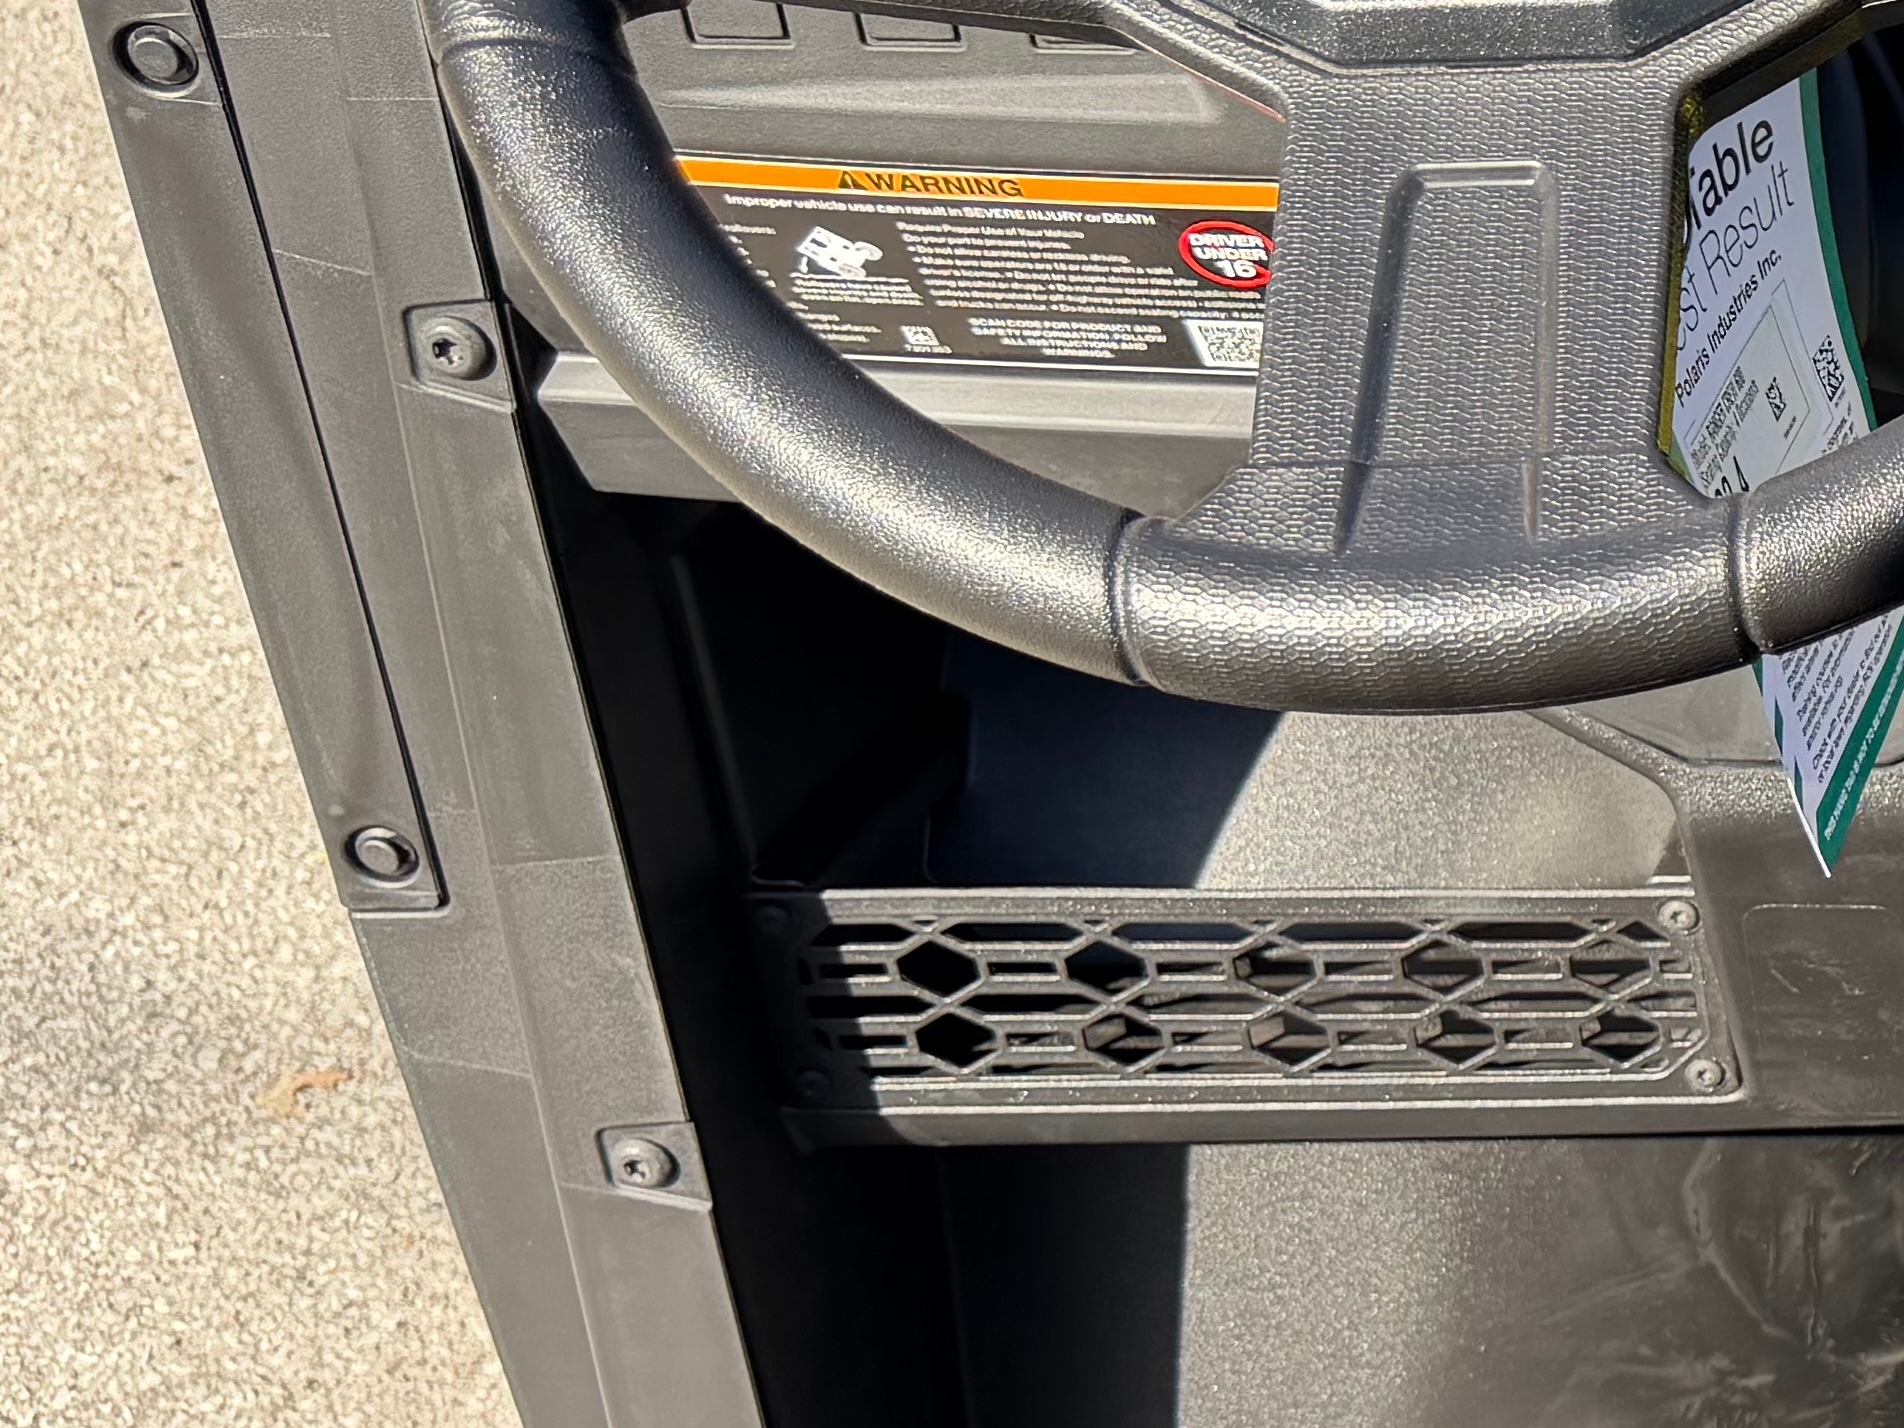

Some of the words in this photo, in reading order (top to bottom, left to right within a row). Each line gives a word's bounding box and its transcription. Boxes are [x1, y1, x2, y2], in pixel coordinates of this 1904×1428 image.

[864, 174, 1023, 196] WARNING
[725, 195, 793, 209] Improper
[794, 198, 846, 211] vehicle
[848, 201, 874, 213] use
[876, 202, 902, 214] can
[905, 204, 945, 216] result
[948, 206, 961, 216] in
[963, 207, 1024, 219] SEVERE
[1027, 210, 1083, 222] INJURY
[1084, 213, 1102, 223] or
[1103, 213, 1155, 225] DEATH
[1699, 161, 1795, 295] Result
[1189, 234, 1264, 247] DRIVER
[1193, 247, 1268, 260] UNDER
[1217, 260, 1256, 277] 16
[969, 318, 1005, 326] SCAN
[1007, 319, 1042, 328] CODE
[1044, 321, 1069, 329] FOR
[1072, 322, 1132, 331] PRODUCT
[1134, 324, 1161, 332] AND
[1676, 347, 1711, 408] Polaris
[1707, 272, 1760, 355] Industries
[1757, 249, 1783, 281] Inc.
[1001, 337, 1026, 345] ALL
[1028, 339, 1118, 349] INSTRUCTIONS
[1121, 342, 1147, 350] AND
[1113, 333, 1167, 341] FOLLOW
